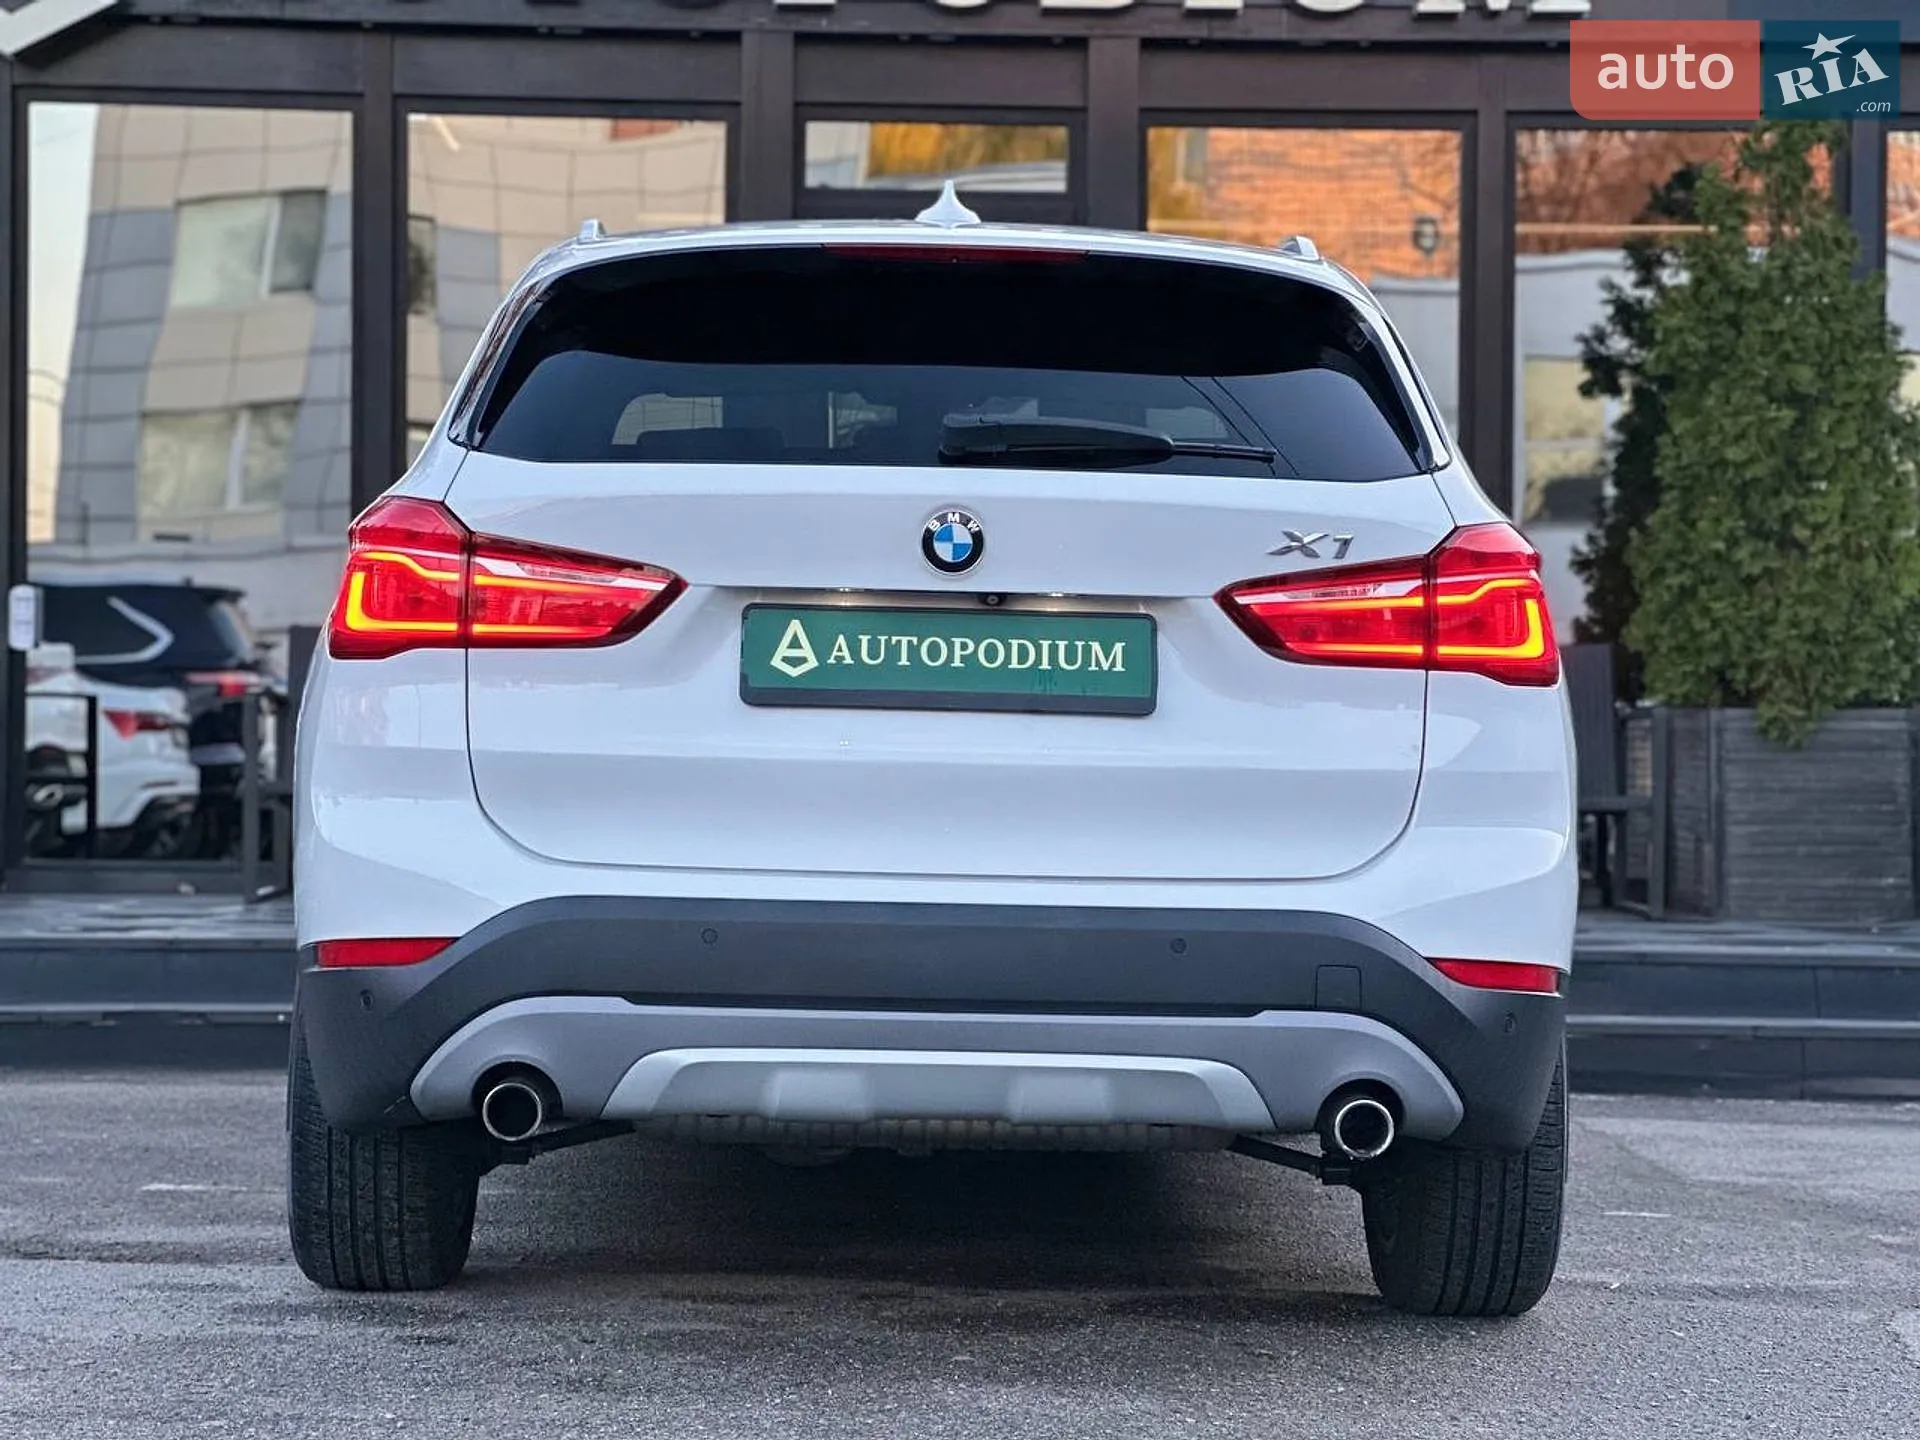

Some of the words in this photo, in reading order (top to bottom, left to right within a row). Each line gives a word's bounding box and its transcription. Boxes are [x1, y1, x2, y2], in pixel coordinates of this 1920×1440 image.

[927, 512, 980, 533] BMW
[1264, 529, 1355, 560] X1
[826, 633, 1126, 672] AUTOPODIUM
